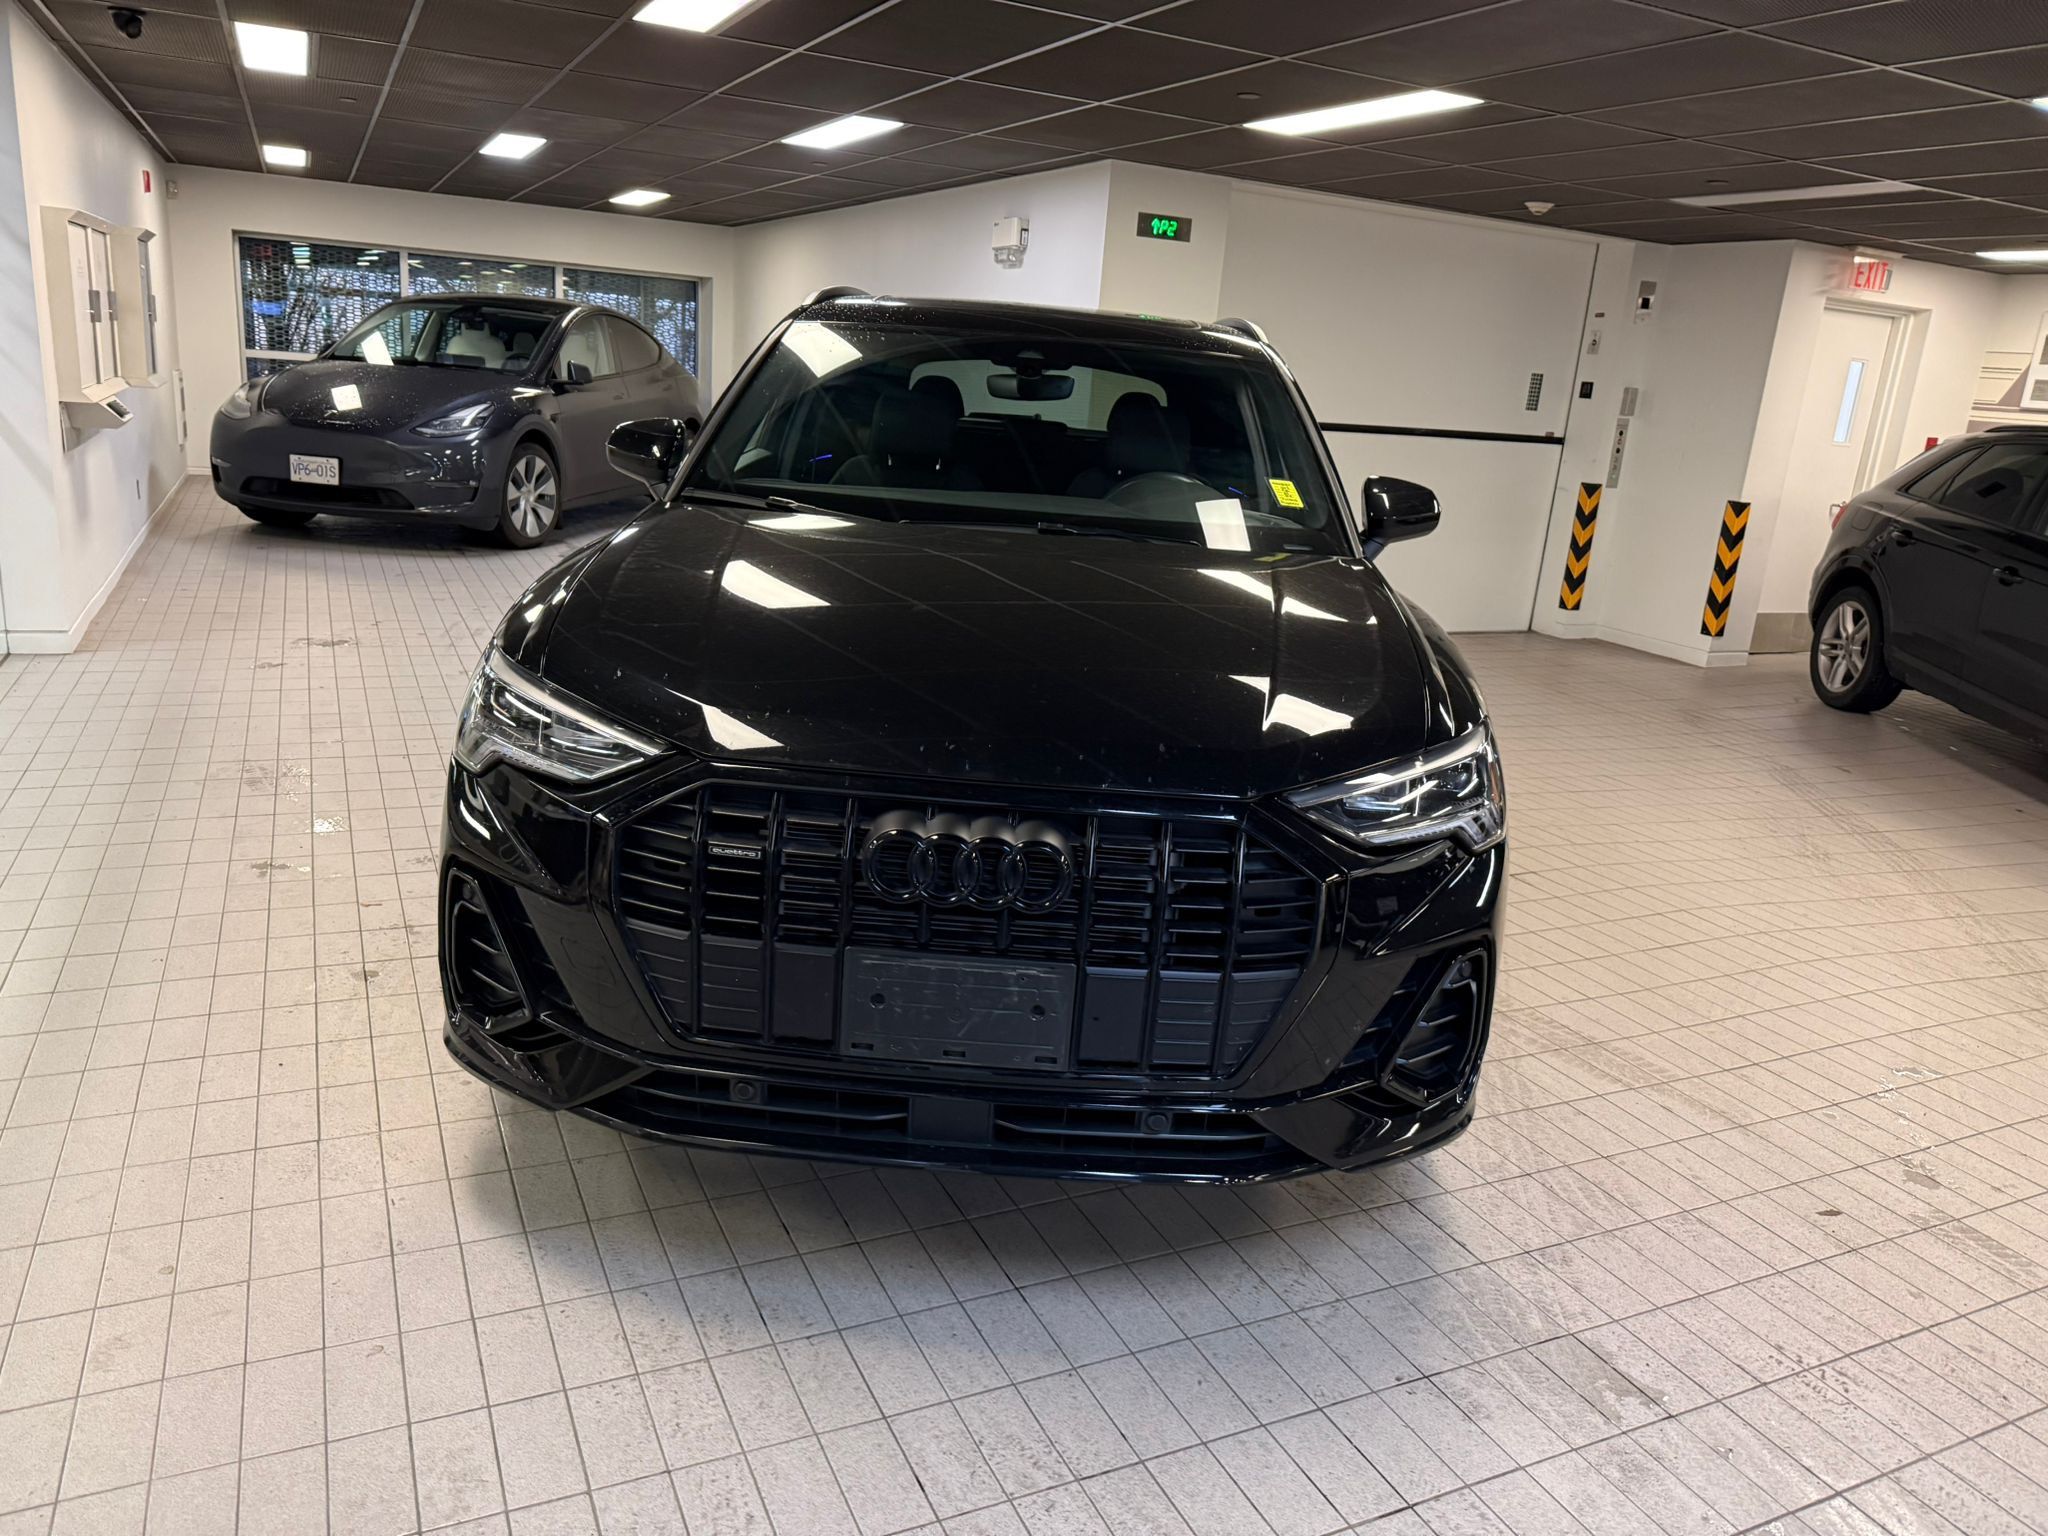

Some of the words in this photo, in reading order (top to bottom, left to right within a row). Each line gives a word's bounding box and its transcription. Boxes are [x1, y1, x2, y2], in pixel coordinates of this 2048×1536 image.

[1159, 219, 1178, 237] P2
[1855, 261, 1889, 290] EXIT
[712, 847, 756, 857] quattro
